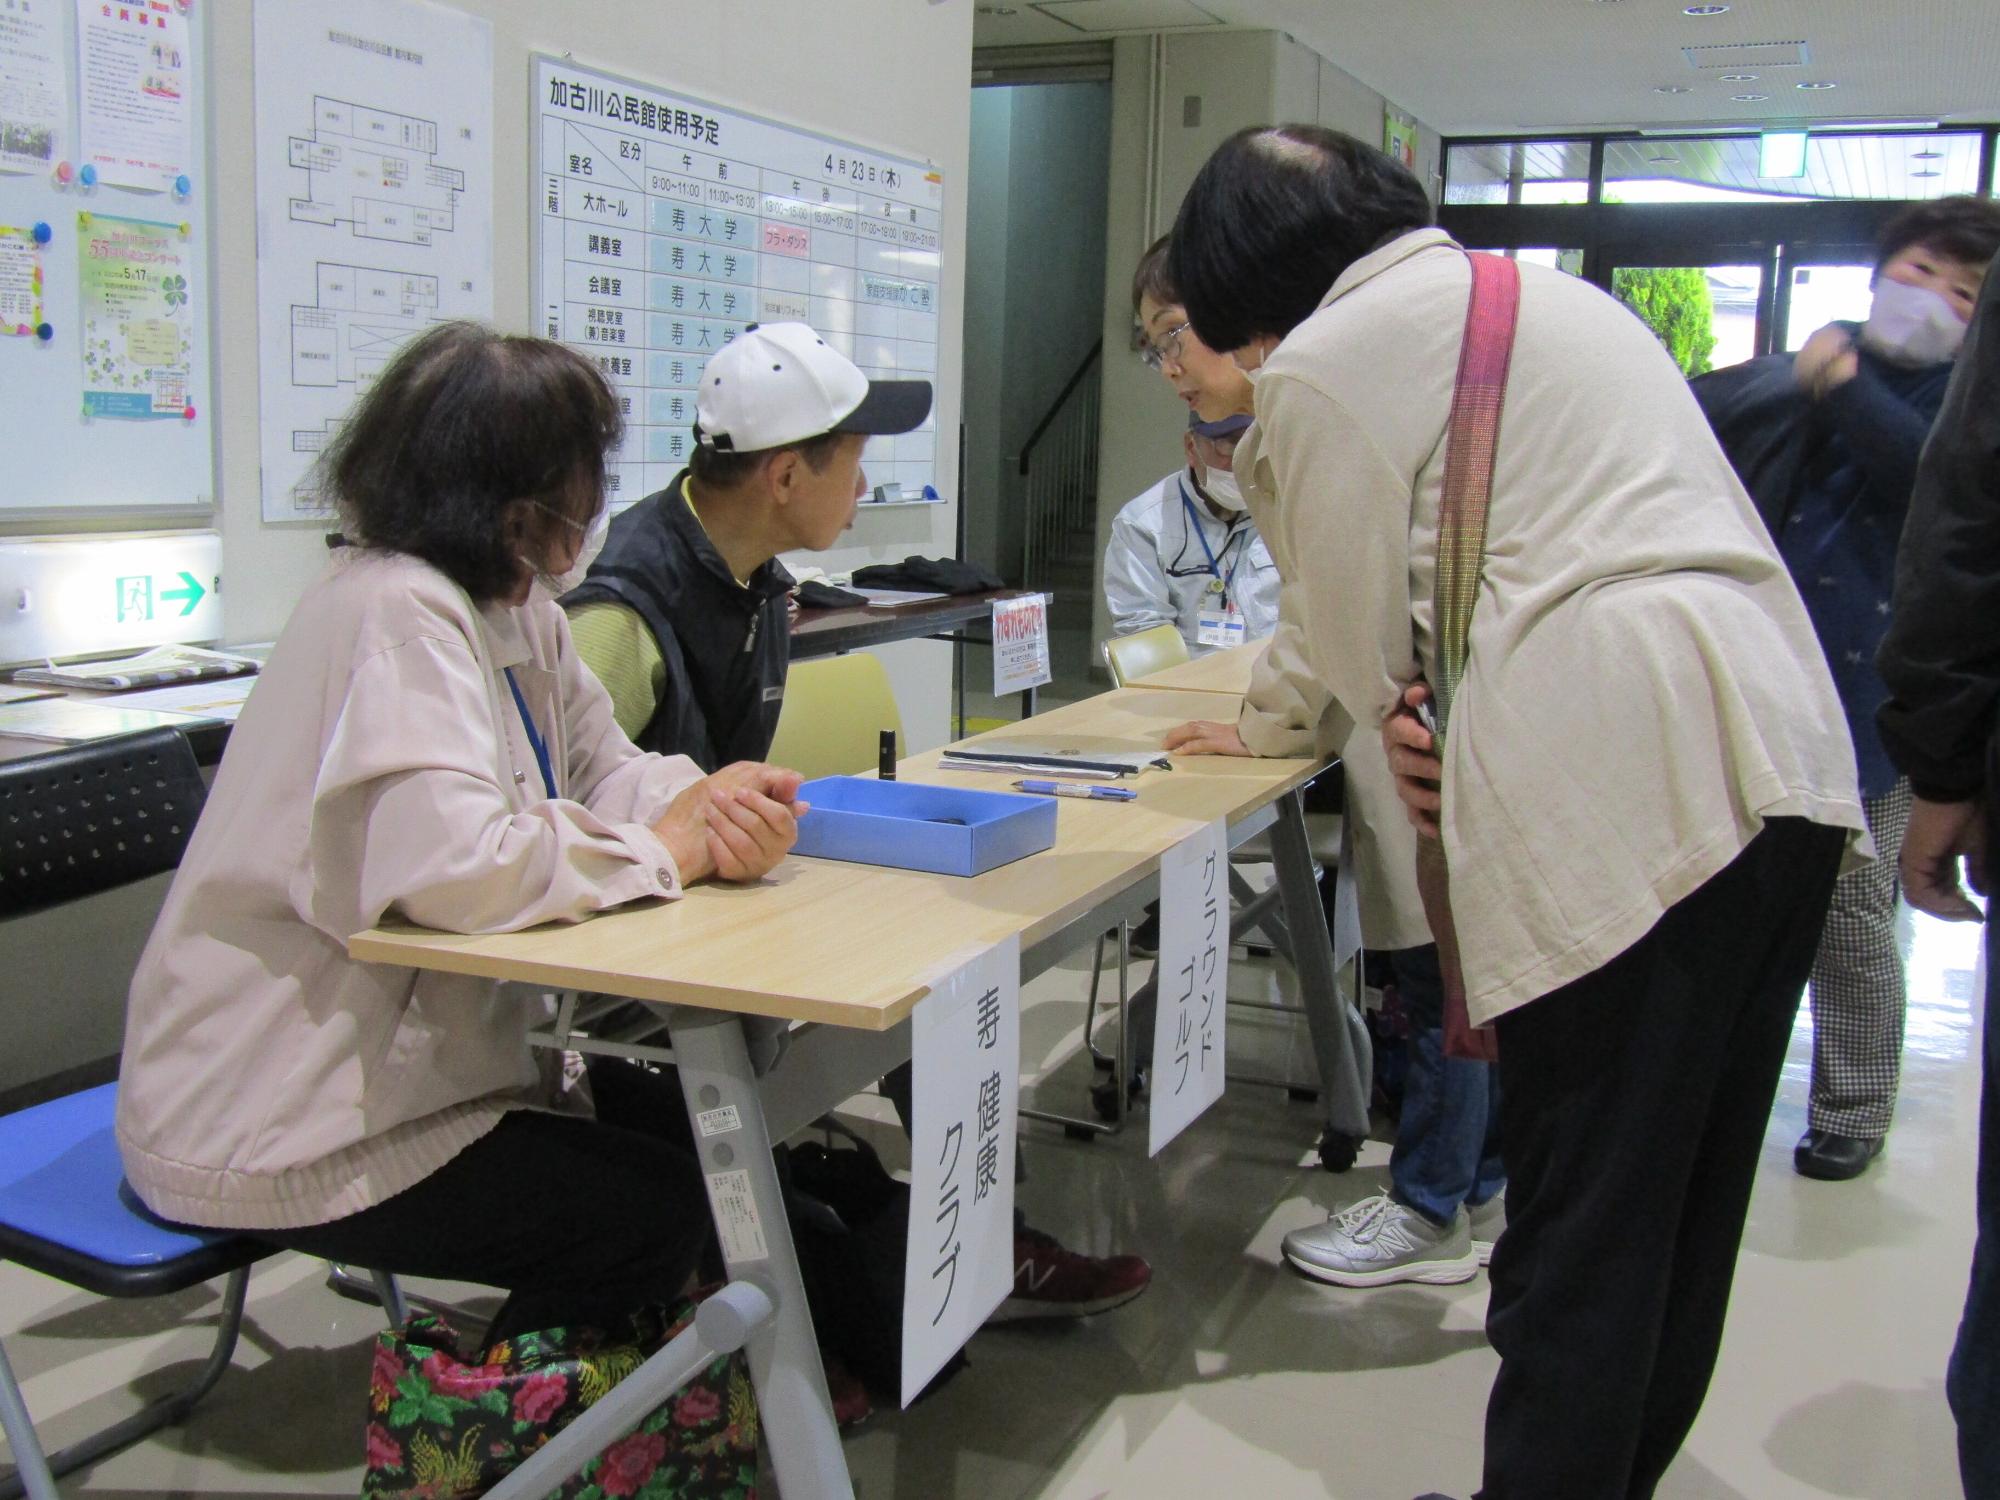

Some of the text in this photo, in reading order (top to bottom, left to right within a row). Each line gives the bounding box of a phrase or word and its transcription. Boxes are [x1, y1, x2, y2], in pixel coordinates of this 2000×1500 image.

[550, 77, 719, 146] 加古川公民館使用予定
[569, 154, 593, 175] 室名
[620, 140, 641, 161] 区分
[584, 192, 628, 217] 大ホール
[672, 208, 736, 240] 寿大学
[589, 235, 622, 256] 講義室
[672, 247, 736, 277] 寿大学
[589, 276, 622, 296] 会議室
[672, 285, 736, 314] 寿大学
[1202, 849, 1218, 1072] グラウンド
[1174, 954, 1196, 1096] ゴルフ
[932, 1121, 964, 1327] クラブ
